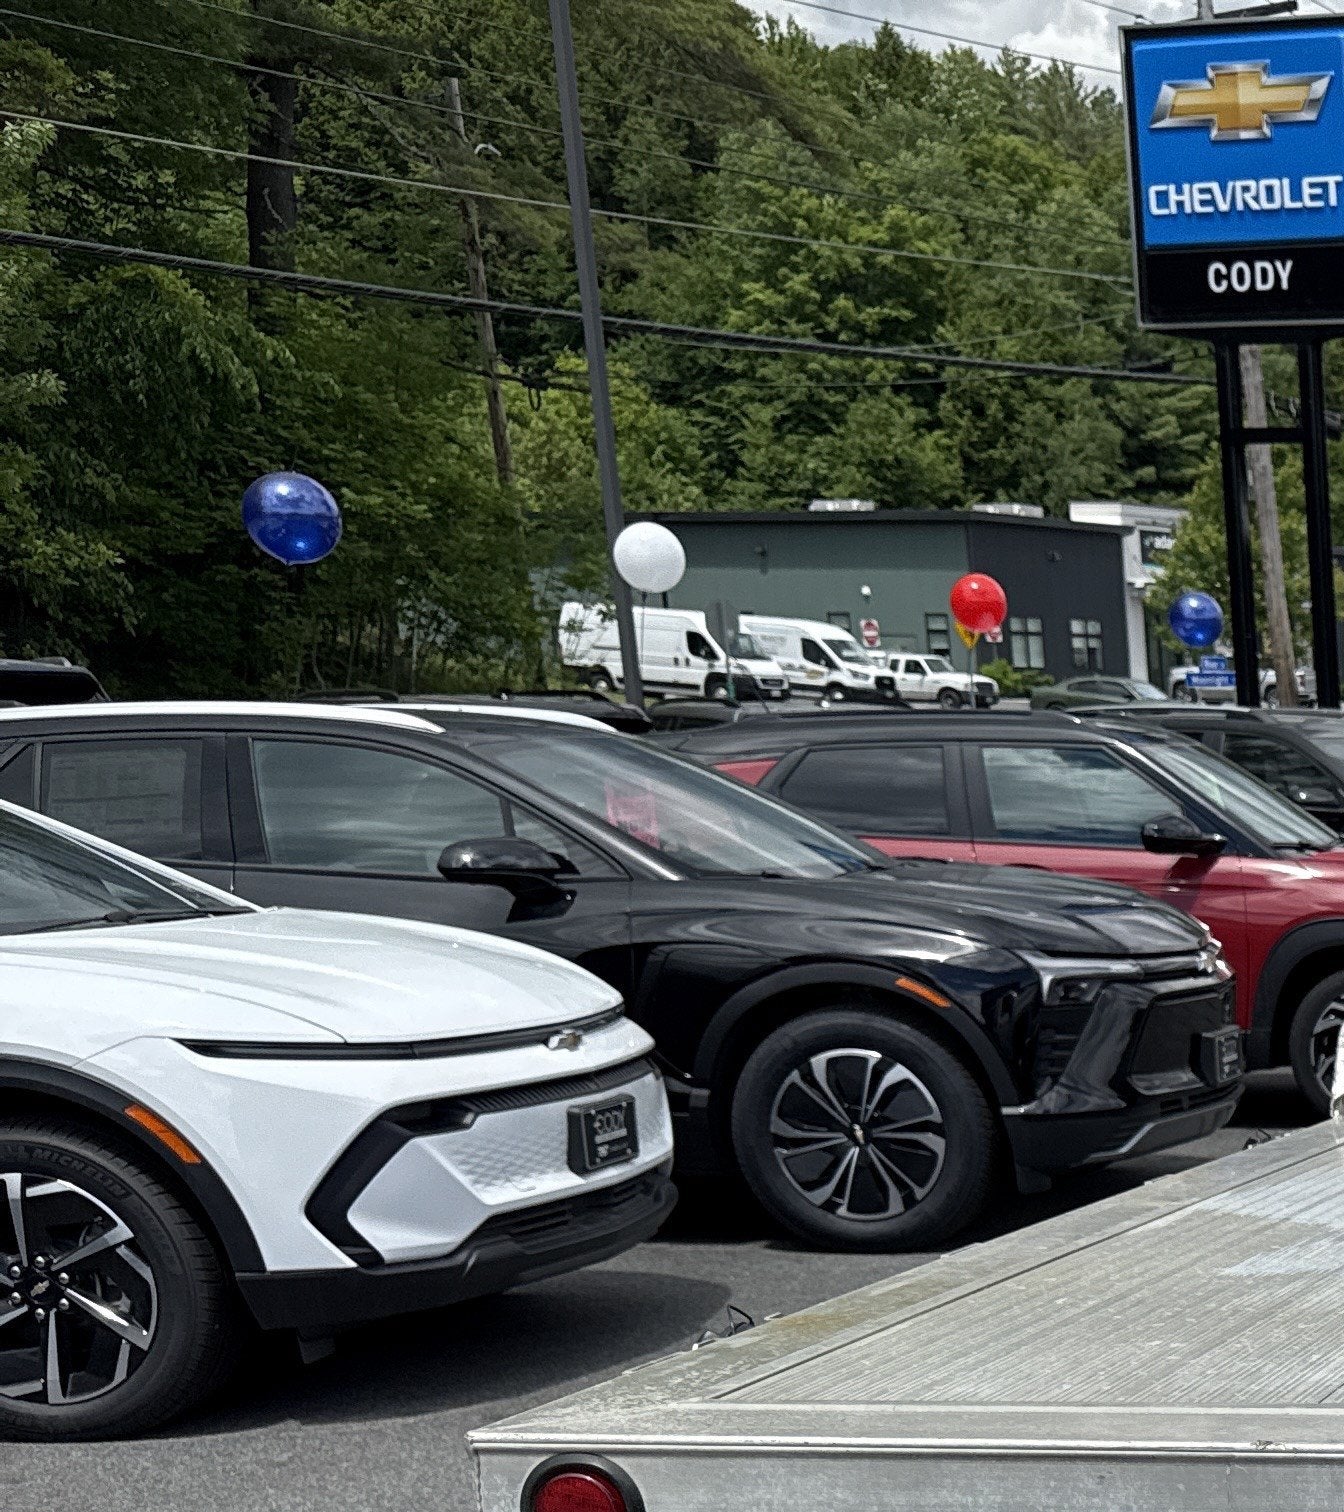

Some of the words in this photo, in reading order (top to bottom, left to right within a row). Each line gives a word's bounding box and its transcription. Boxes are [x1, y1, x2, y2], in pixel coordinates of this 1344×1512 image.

[1149, 175, 1344, 216] CHEVROLET
[1207, 259, 1293, 294] CODY
[31, 1148, 127, 1197] MICHELIN
